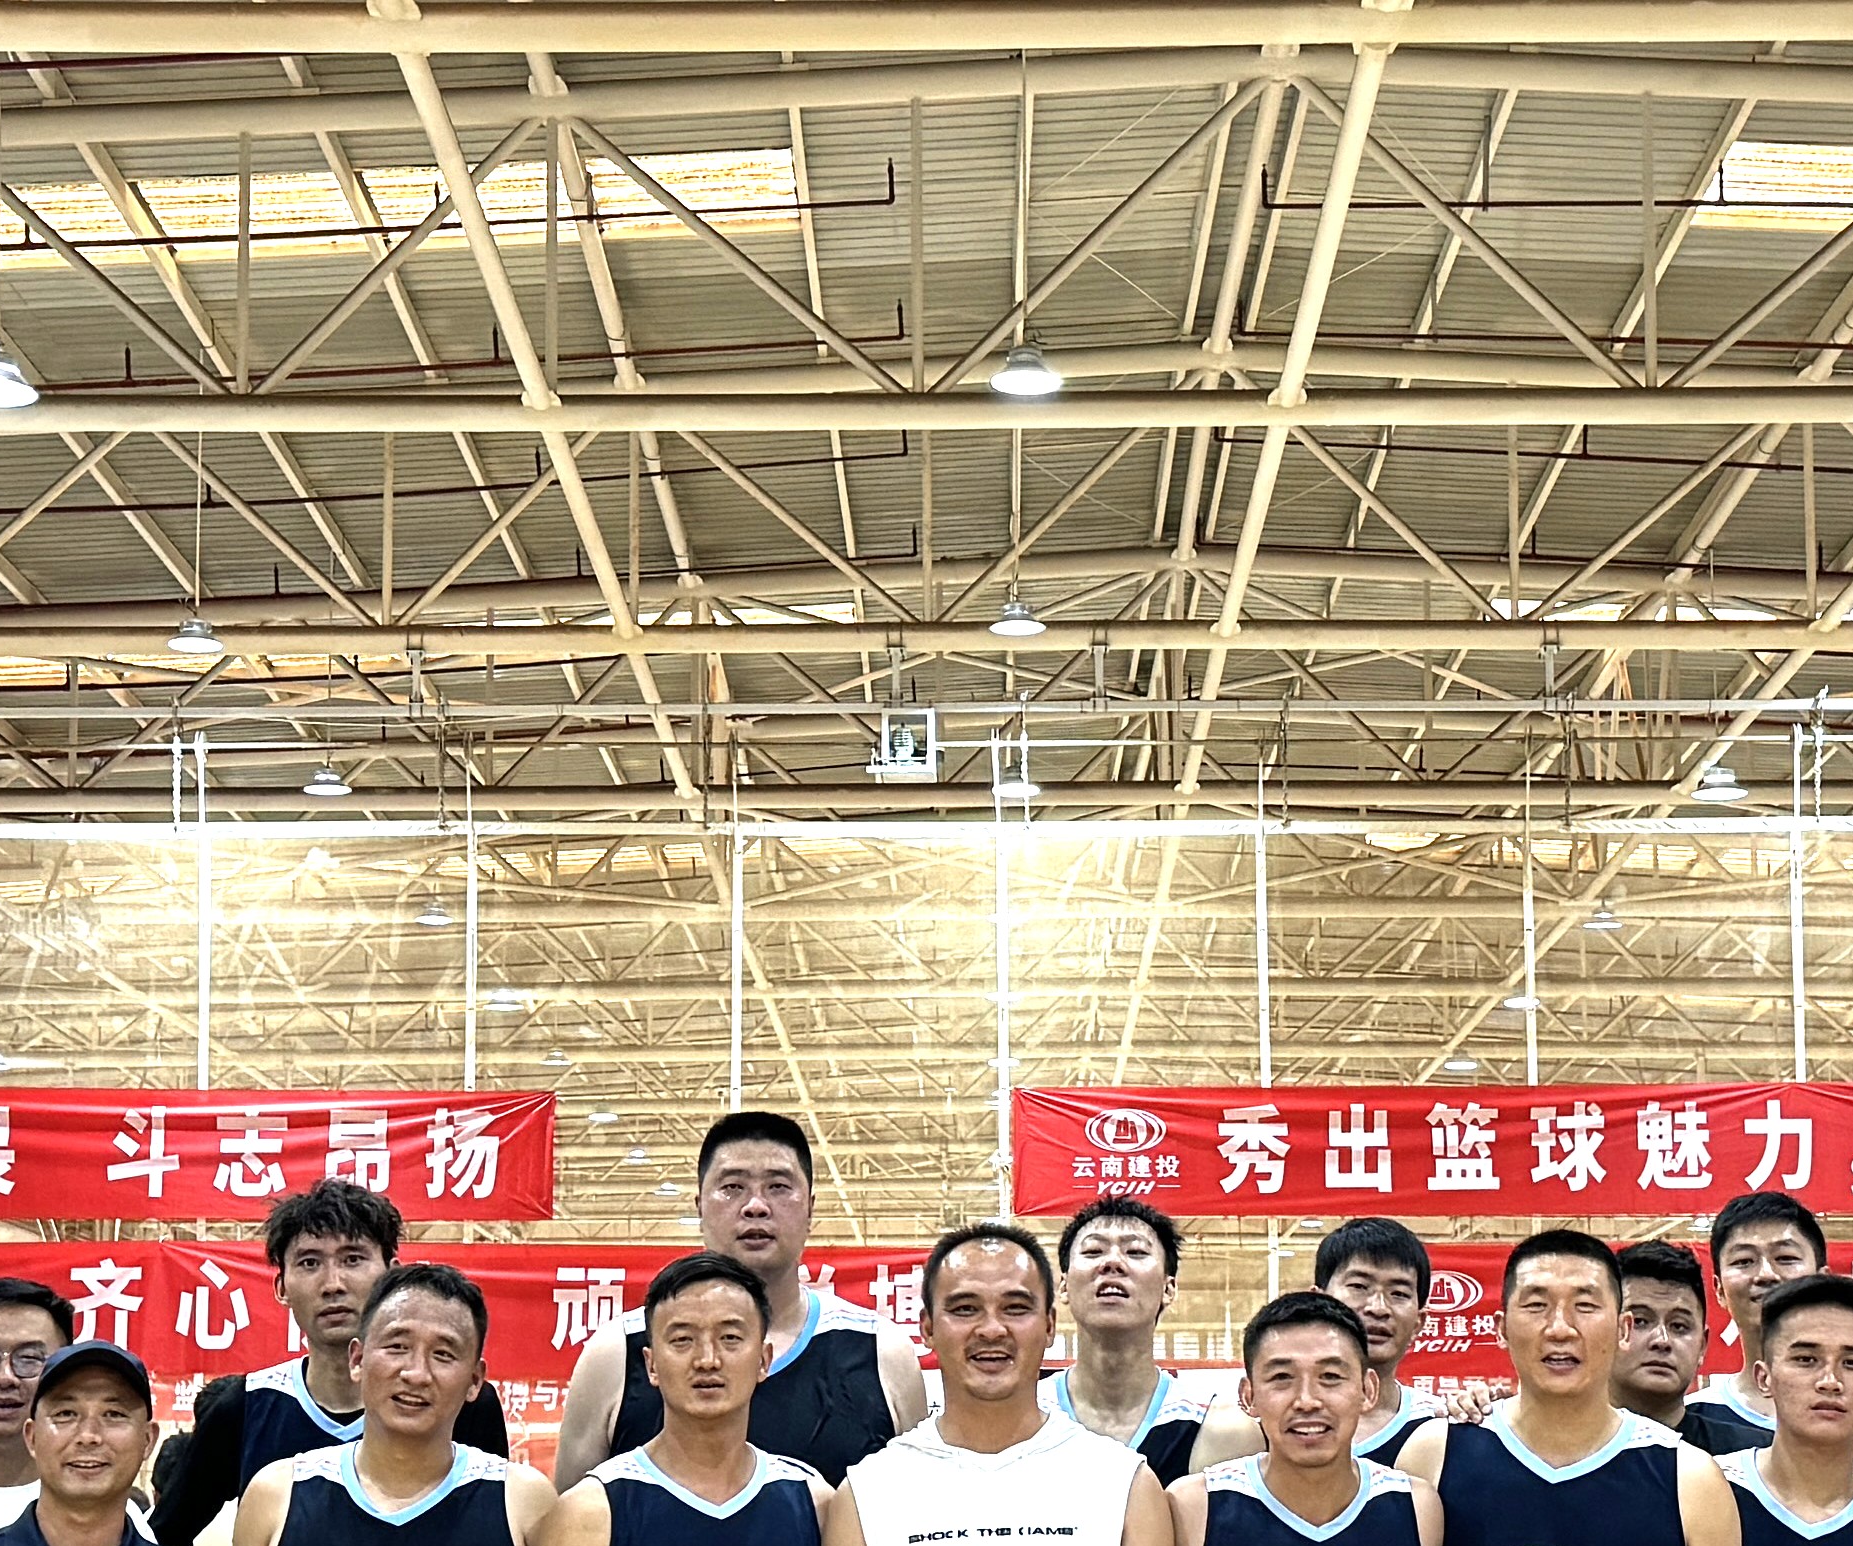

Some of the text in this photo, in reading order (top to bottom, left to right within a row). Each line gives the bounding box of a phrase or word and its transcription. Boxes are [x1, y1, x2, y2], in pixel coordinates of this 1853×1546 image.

[106, 1106, 501, 1199] 斗志昂扬
[1071, 1154, 1181, 1178] 云南建投
[1097, 1180, 1155, 1196] YCIH
[1412, 1339, 1473, 1353] YCIH
